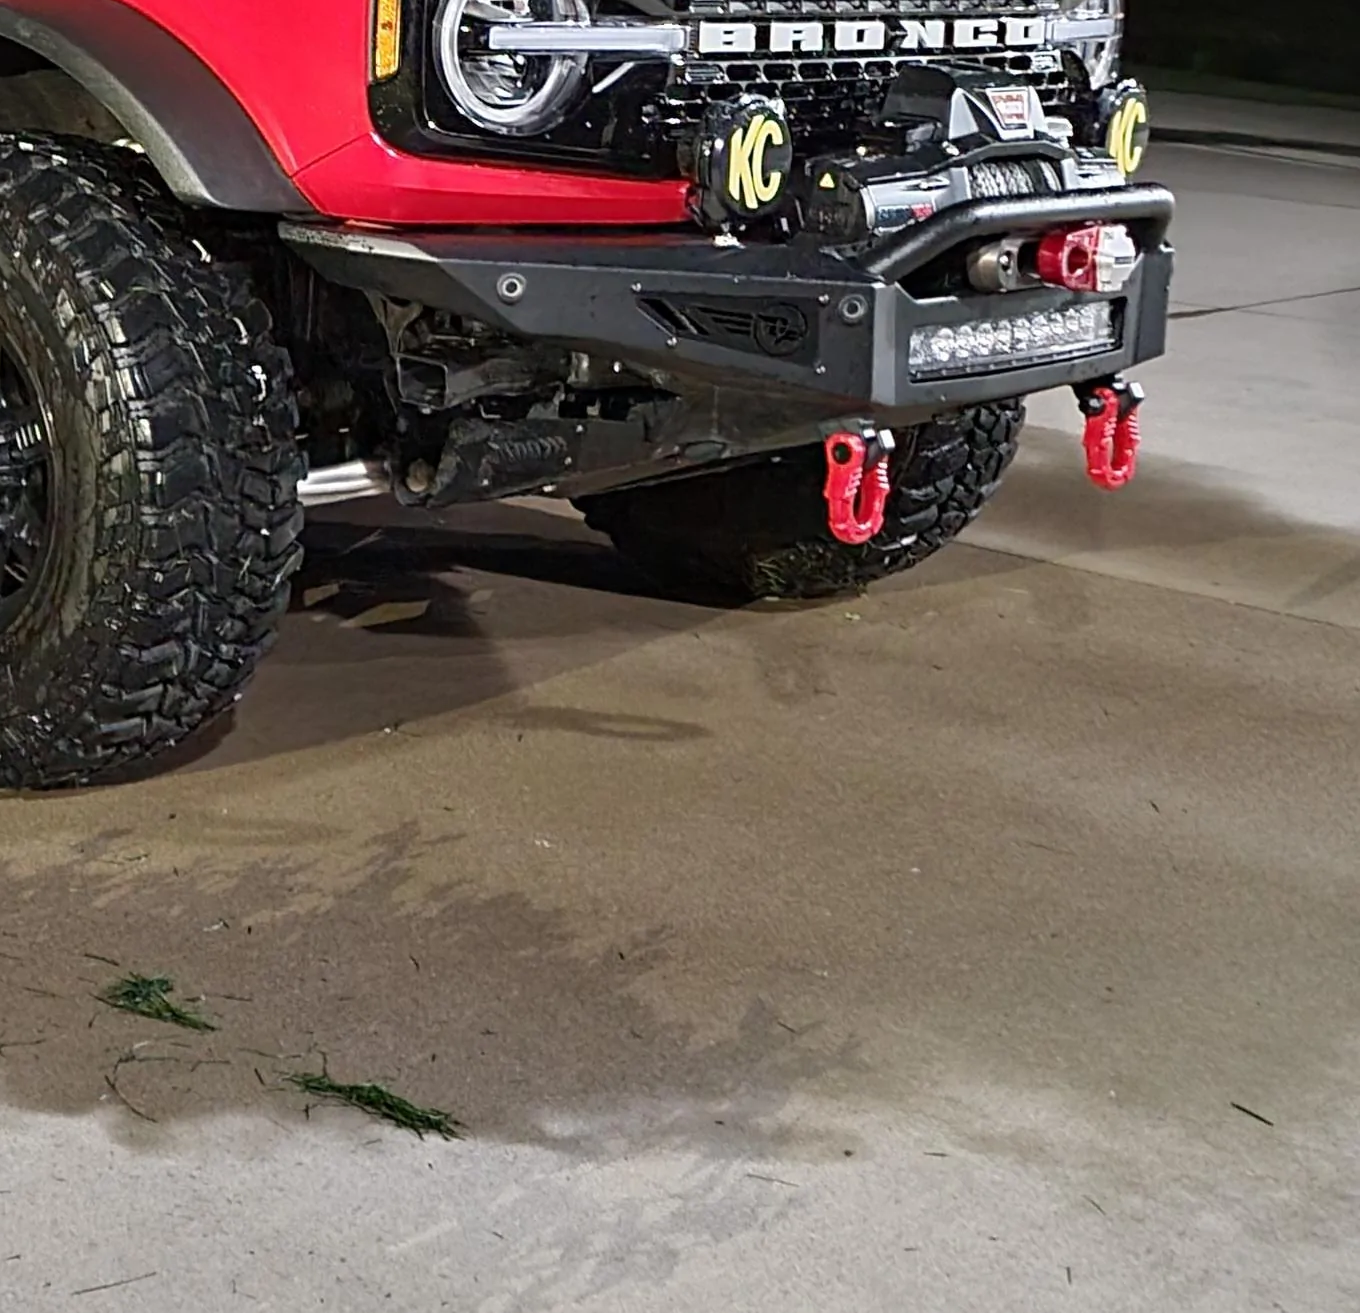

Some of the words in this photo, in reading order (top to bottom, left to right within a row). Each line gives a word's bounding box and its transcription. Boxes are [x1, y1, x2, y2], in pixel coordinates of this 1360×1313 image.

[698, 16, 1046, 54] BRONCO
[728, 114, 783, 209] KC
[1109, 97, 1146, 176] KC
